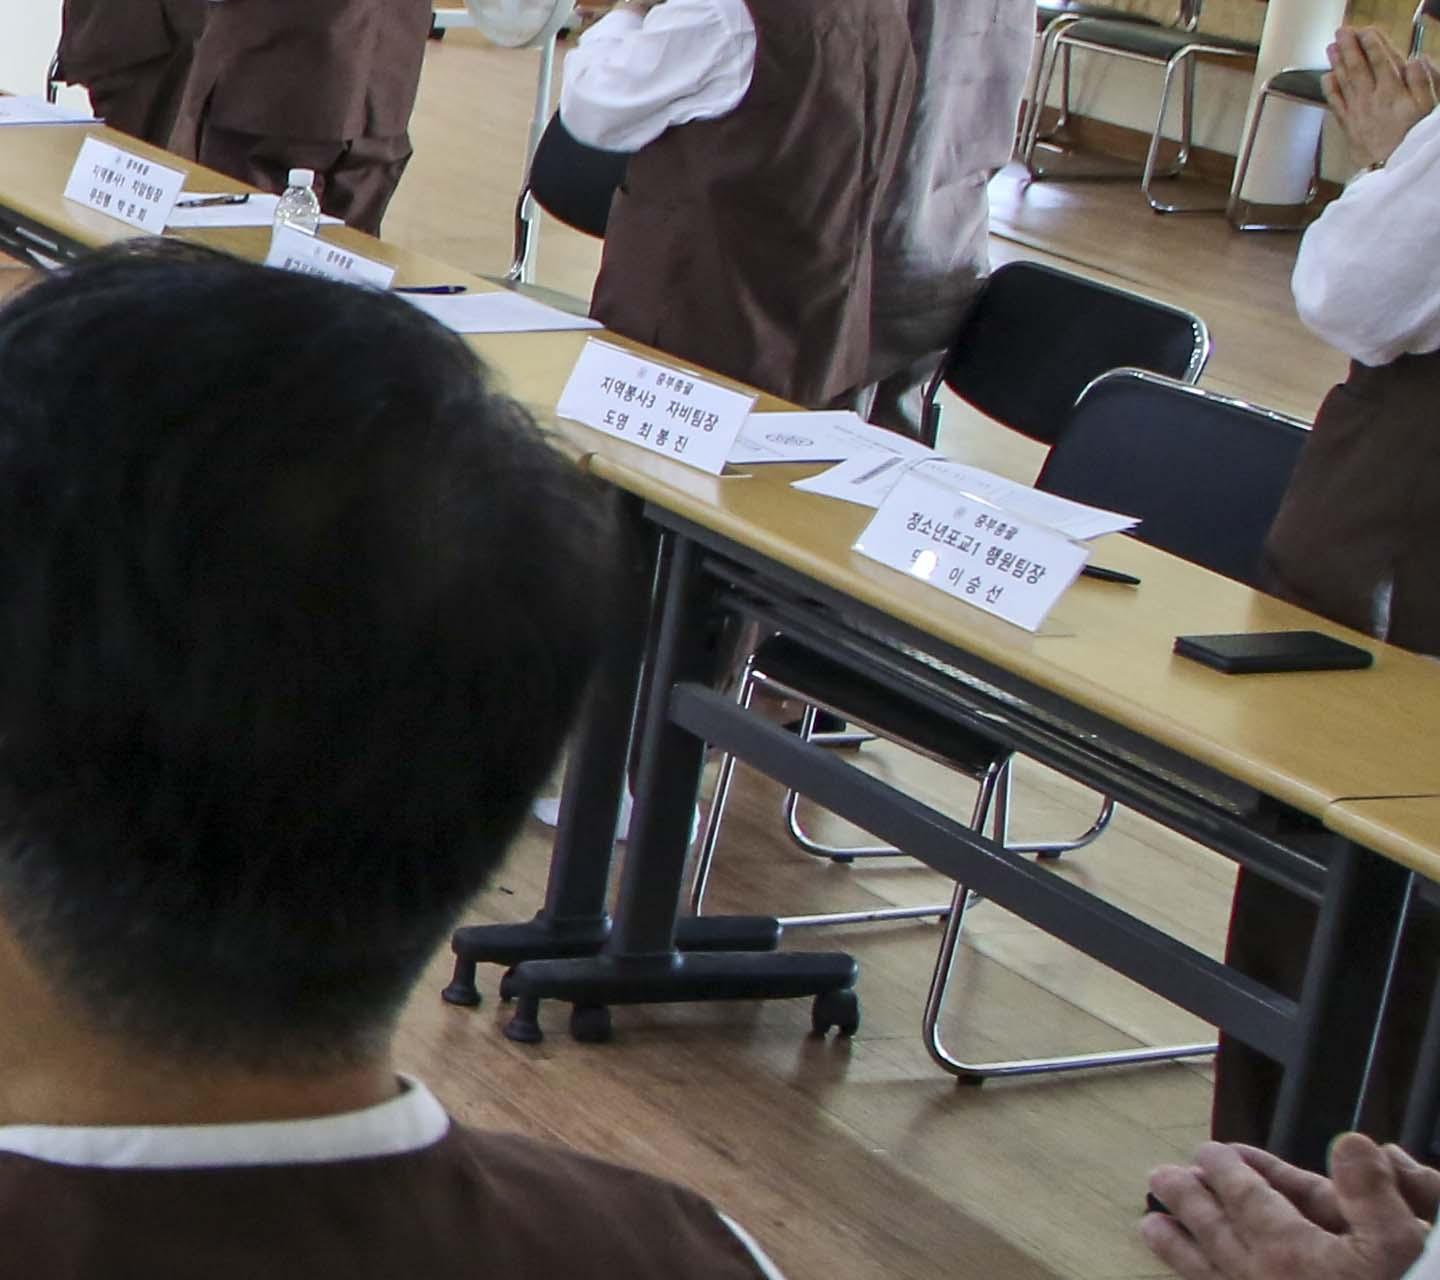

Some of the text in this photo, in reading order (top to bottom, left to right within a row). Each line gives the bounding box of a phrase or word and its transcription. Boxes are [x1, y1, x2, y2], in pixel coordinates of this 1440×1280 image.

[600, 376, 719, 433] 지역봉사3 자비팀장
[655, 372, 695, 396] 중부총괄
[906, 511, 1046, 585] 청소년포교1 행원팀장
[974, 513, 1020, 542] 중부총괄
